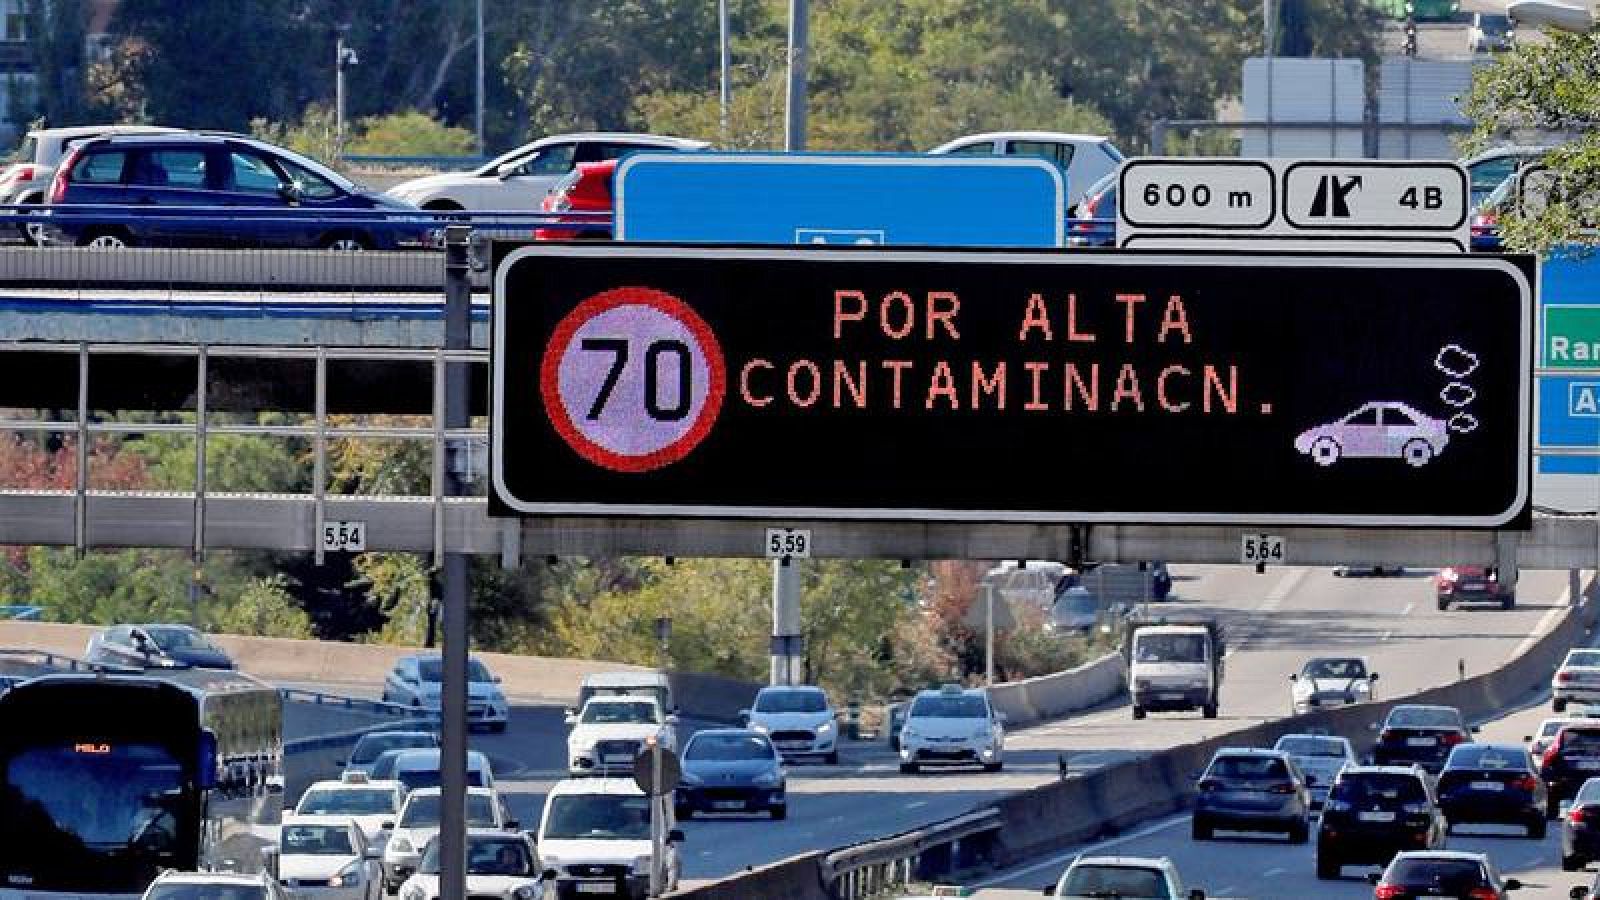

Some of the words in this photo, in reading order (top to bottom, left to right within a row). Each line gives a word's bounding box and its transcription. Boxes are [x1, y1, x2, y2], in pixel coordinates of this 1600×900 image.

[1143, 183, 1211, 207] 600
[1228, 190, 1252, 207] m
[1398, 187, 1443, 209] 4B
[833, 289, 961, 339] POR
[1019, 293, 1192, 343] ALTA
[581, 338, 693, 422] 70
[739, 358, 1274, 414] CONTAMINACN.
[1575, 387, 1600, 413] A
[325, 527, 359, 546] 5,54
[771, 534, 805, 553] 5,59
[1245, 539, 1281, 560] 5,64
